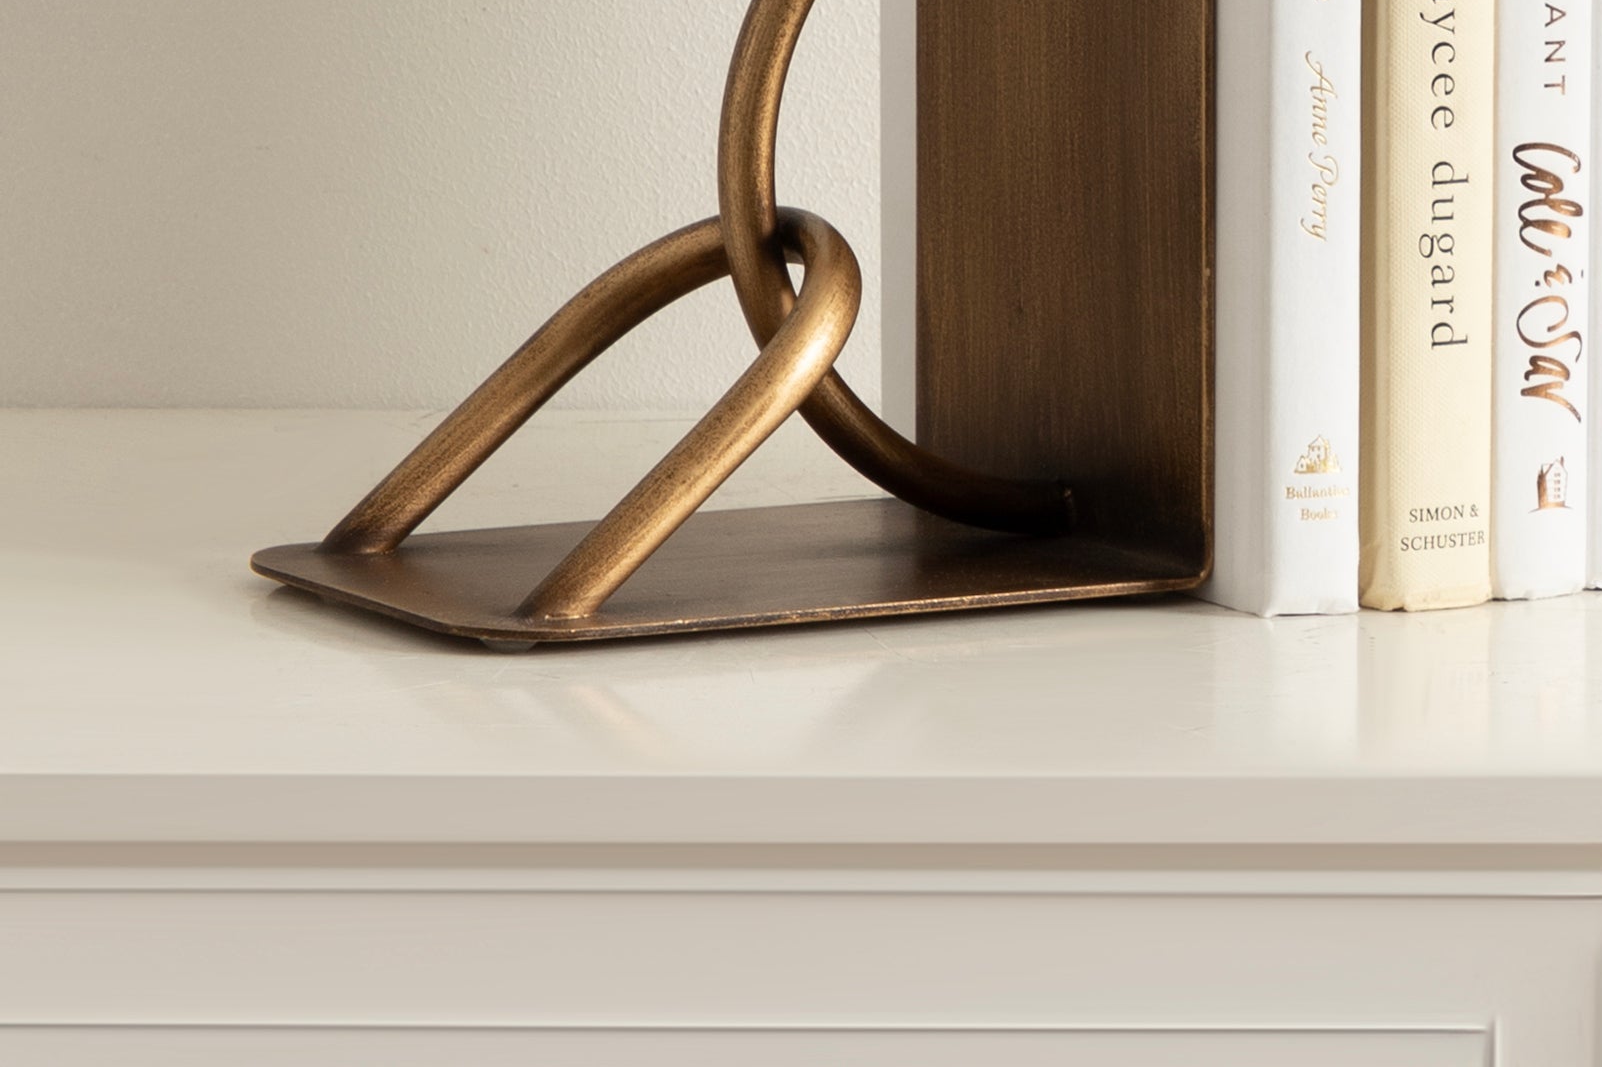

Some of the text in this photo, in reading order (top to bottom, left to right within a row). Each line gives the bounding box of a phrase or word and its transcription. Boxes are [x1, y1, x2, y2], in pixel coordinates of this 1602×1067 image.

[1300, 50, 1339, 242] Anne Perry
[1512, 142, 1584, 257] Cole
[1418, 160, 1470, 350] dugard
[1400, 531, 1485, 552] SCHUSTER
[1409, 504, 1479, 523] SIMON &
